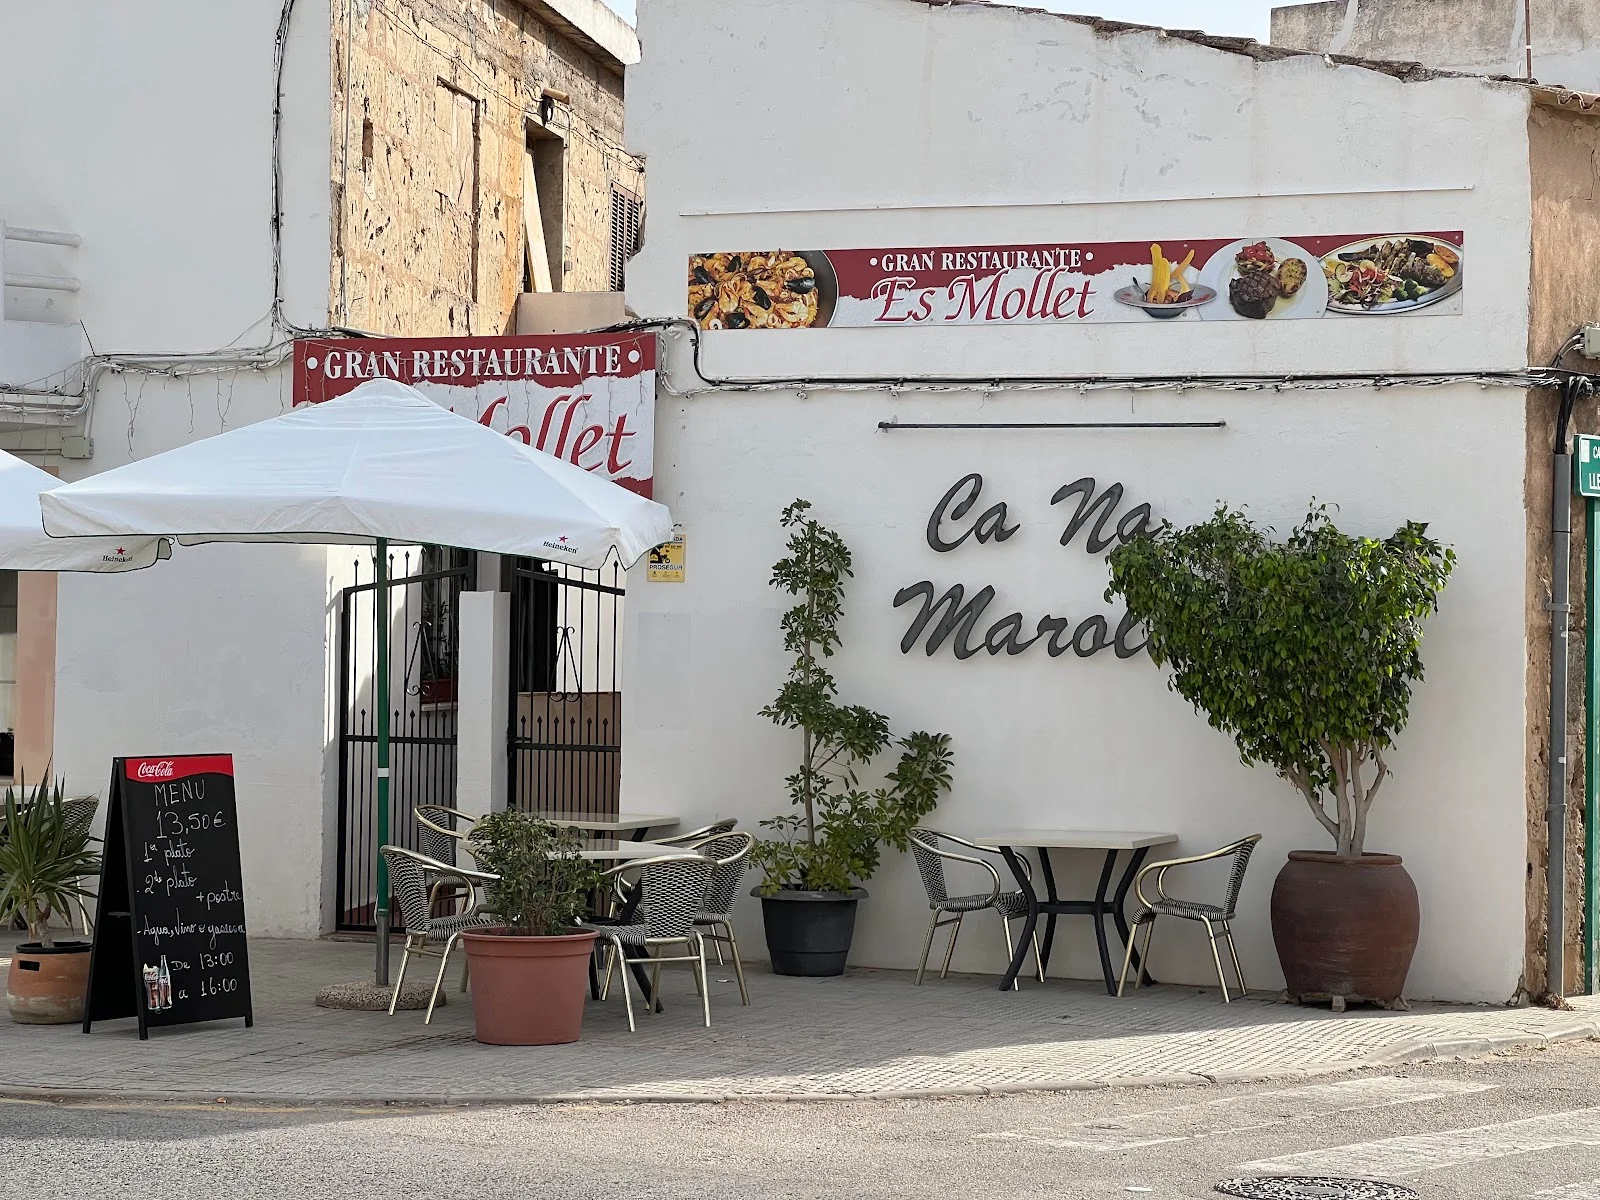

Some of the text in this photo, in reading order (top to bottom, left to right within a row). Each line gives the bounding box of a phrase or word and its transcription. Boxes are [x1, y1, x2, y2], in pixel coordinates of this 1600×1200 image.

[881, 248, 1082, 272] GRAN RESTAURANTE
[870, 264, 1099, 323] Es Mollet
[324, 345, 622, 380] GRAN RESTAURANTE
[926, 473, 1165, 554] Ca Na
[542, 541, 579, 554] Heineken
[154, 779, 205, 807] MENU
[164, 838, 196, 867] plato
[166, 862, 198, 897] plato
[199, 951, 234, 970] 13:00
[201, 976, 238, 998] 16:00
